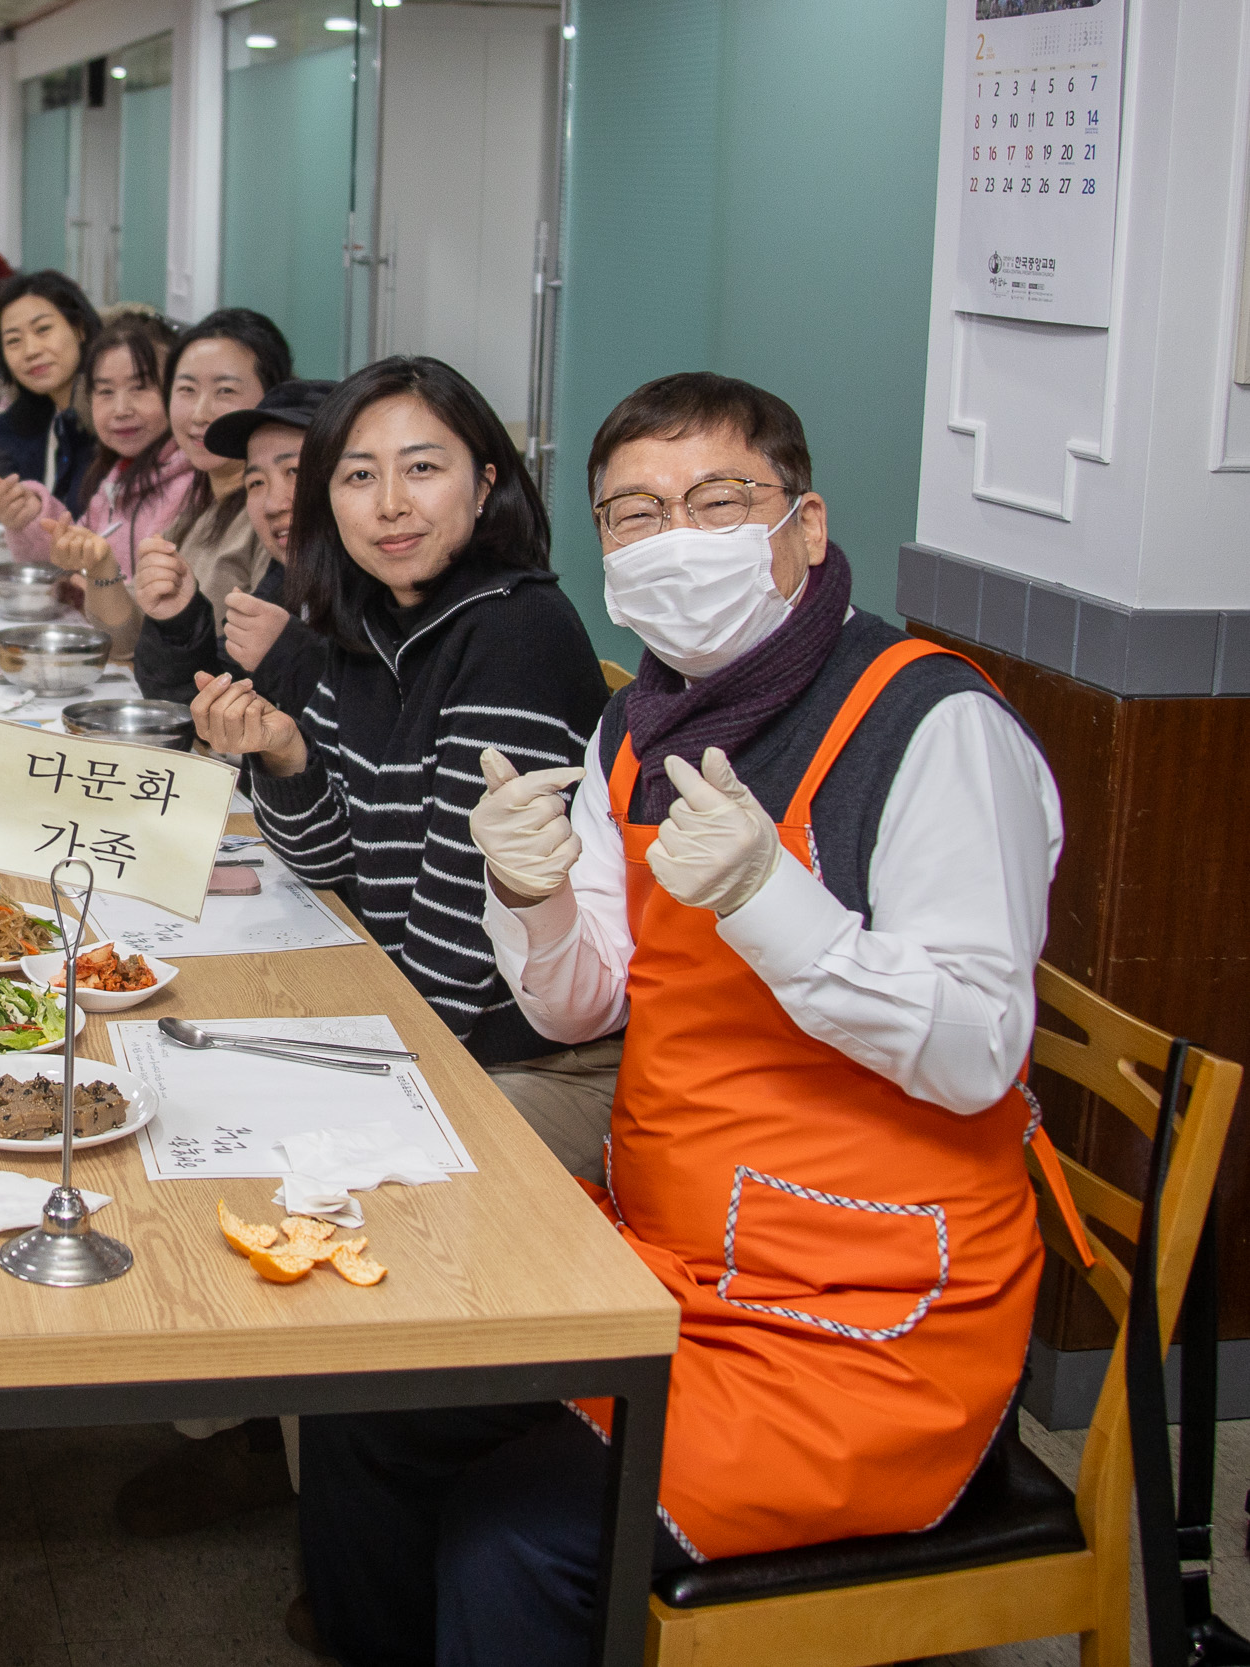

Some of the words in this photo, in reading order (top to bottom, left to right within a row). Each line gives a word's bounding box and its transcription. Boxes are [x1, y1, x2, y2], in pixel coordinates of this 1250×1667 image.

[975, 33, 985, 60] 2
[994, 82, 1000, 97] 2
[1012, 80, 1019, 96] 3
[1030, 80, 1036, 94] 4
[1048, 78, 1055, 93] 5
[1068, 77, 1074, 93] 6
[1091, 75, 1098, 91] 7
[974, 114, 980, 129] 8
[992, 114, 998, 128] 9
[1010, 113, 1019, 128] 10
[1028, 112, 1035, 128] 11
[1045, 111, 1054, 127] 12
[1065, 110, 1075, 126] 13
[1087, 109, 1099, 126] 14
[972, 146, 980, 160] 15
[989, 146, 997, 160] 16
[1007, 145, 1016, 160] 17
[1025, 145, 1034, 160] 18
[1043, 144, 1052, 160] 19
[1061, 144, 1073, 160] 20
[1084, 144, 1096, 160] 21
[970, 177, 978, 192] 22
[985, 177, 995, 192] 23
[1002, 178, 1013, 193] 24
[1020, 178, 1031, 193] 25
[1038, 178, 1050, 193] 26
[1059, 178, 1071, 194] 27
[1082, 178, 1096, 194] 28
[1015, 256, 1056, 272] 한국중앙교회
[27, 751, 180, 816] 다문화
[34, 820, 137, 879] 가족
[211, 1125, 253, 1154] 만남
[168, 1135, 206, 1169] 행복한
